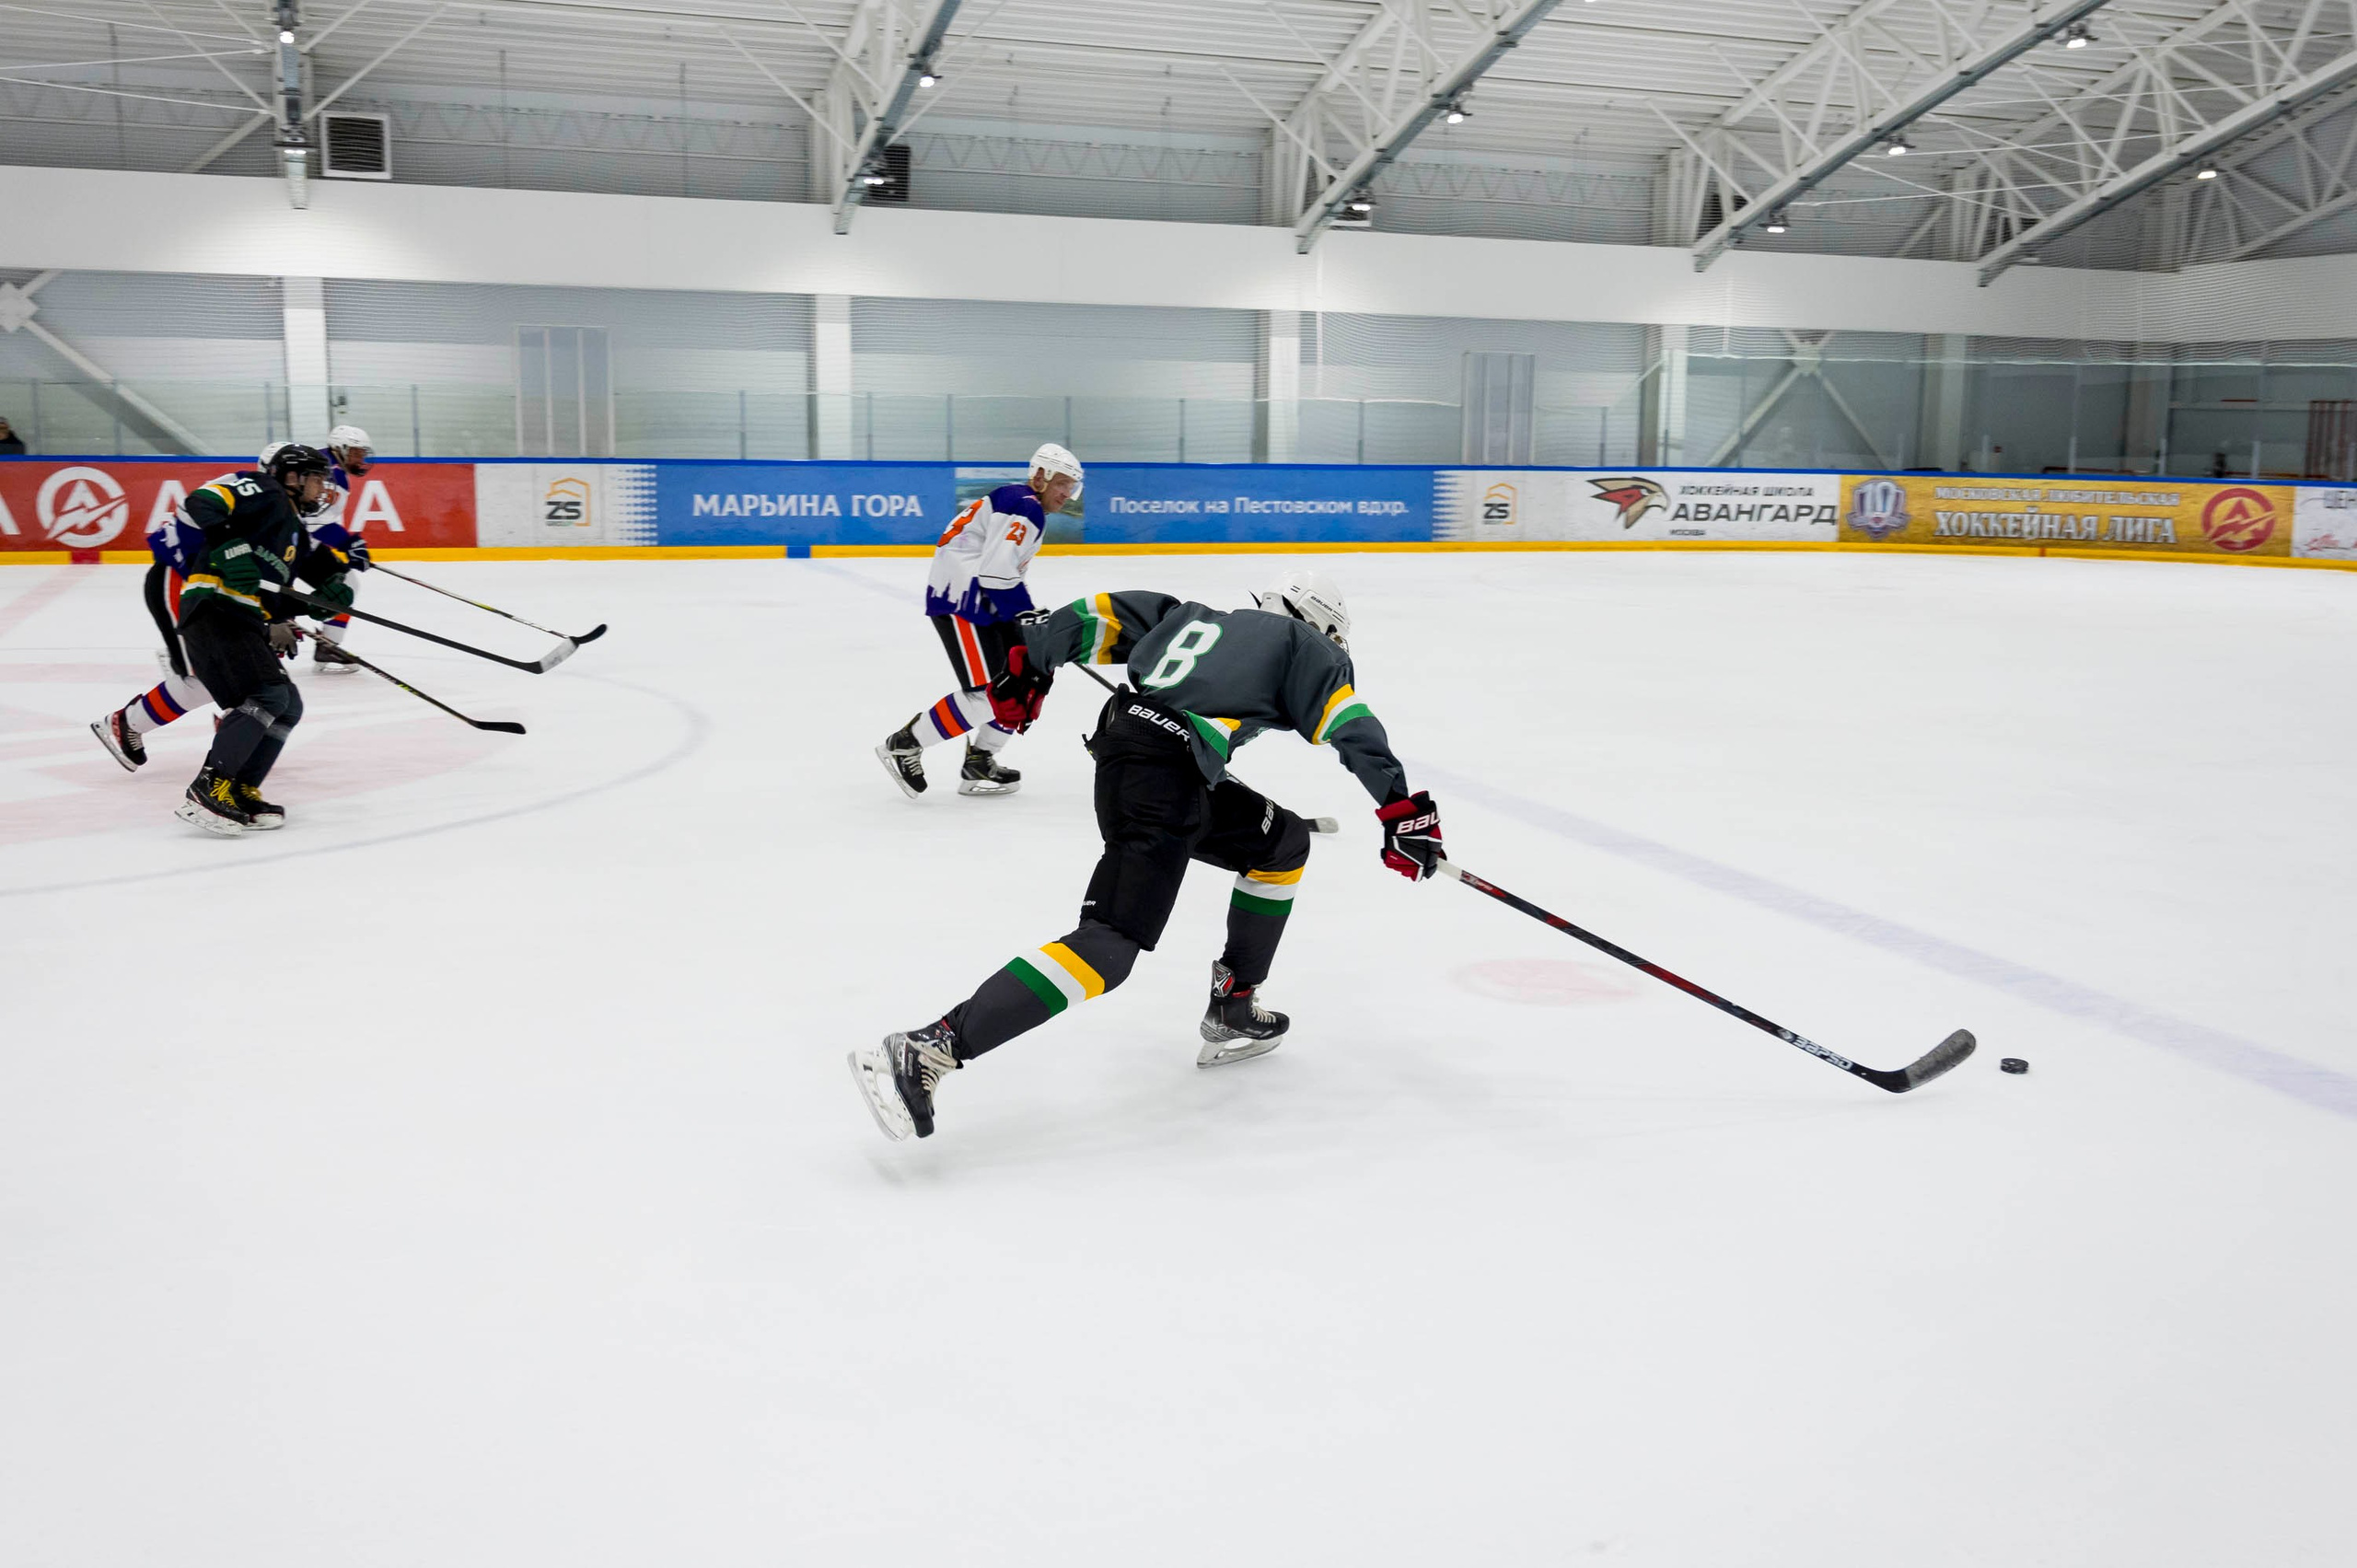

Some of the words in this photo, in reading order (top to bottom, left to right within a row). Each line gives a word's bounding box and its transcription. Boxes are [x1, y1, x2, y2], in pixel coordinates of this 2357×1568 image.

[1678, 484, 1759, 497] ХОККЕЙНАЯ
[1763, 486, 1814, 497] ШКОЛА
[1934, 487, 2041, 502] МОСКОВСКАЯ
[2043, 489, 2180, 506] ЛЮБИТЕЛЬСКАЯ
[545, 501, 581, 520] ZS
[692, 494, 842, 517] МАРЬИНА
[851, 494, 924, 517] ГОРА
[1109, 496, 1200, 514] Поселок
[1204, 500, 1229, 514] на
[1234, 496, 1353, 514] Пестовском
[1357, 500, 1409, 516] вдхр.
[1483, 503, 1510, 519] ZS
[1670, 503, 1838, 525] АВАНГАРД
[1005, 521, 1028, 546] 23
[1934, 505, 2099, 540] ХОККЕЙНАЯ
[2103, 515, 2177, 543] ЛИГА
[1141, 619, 1224, 689] 8
